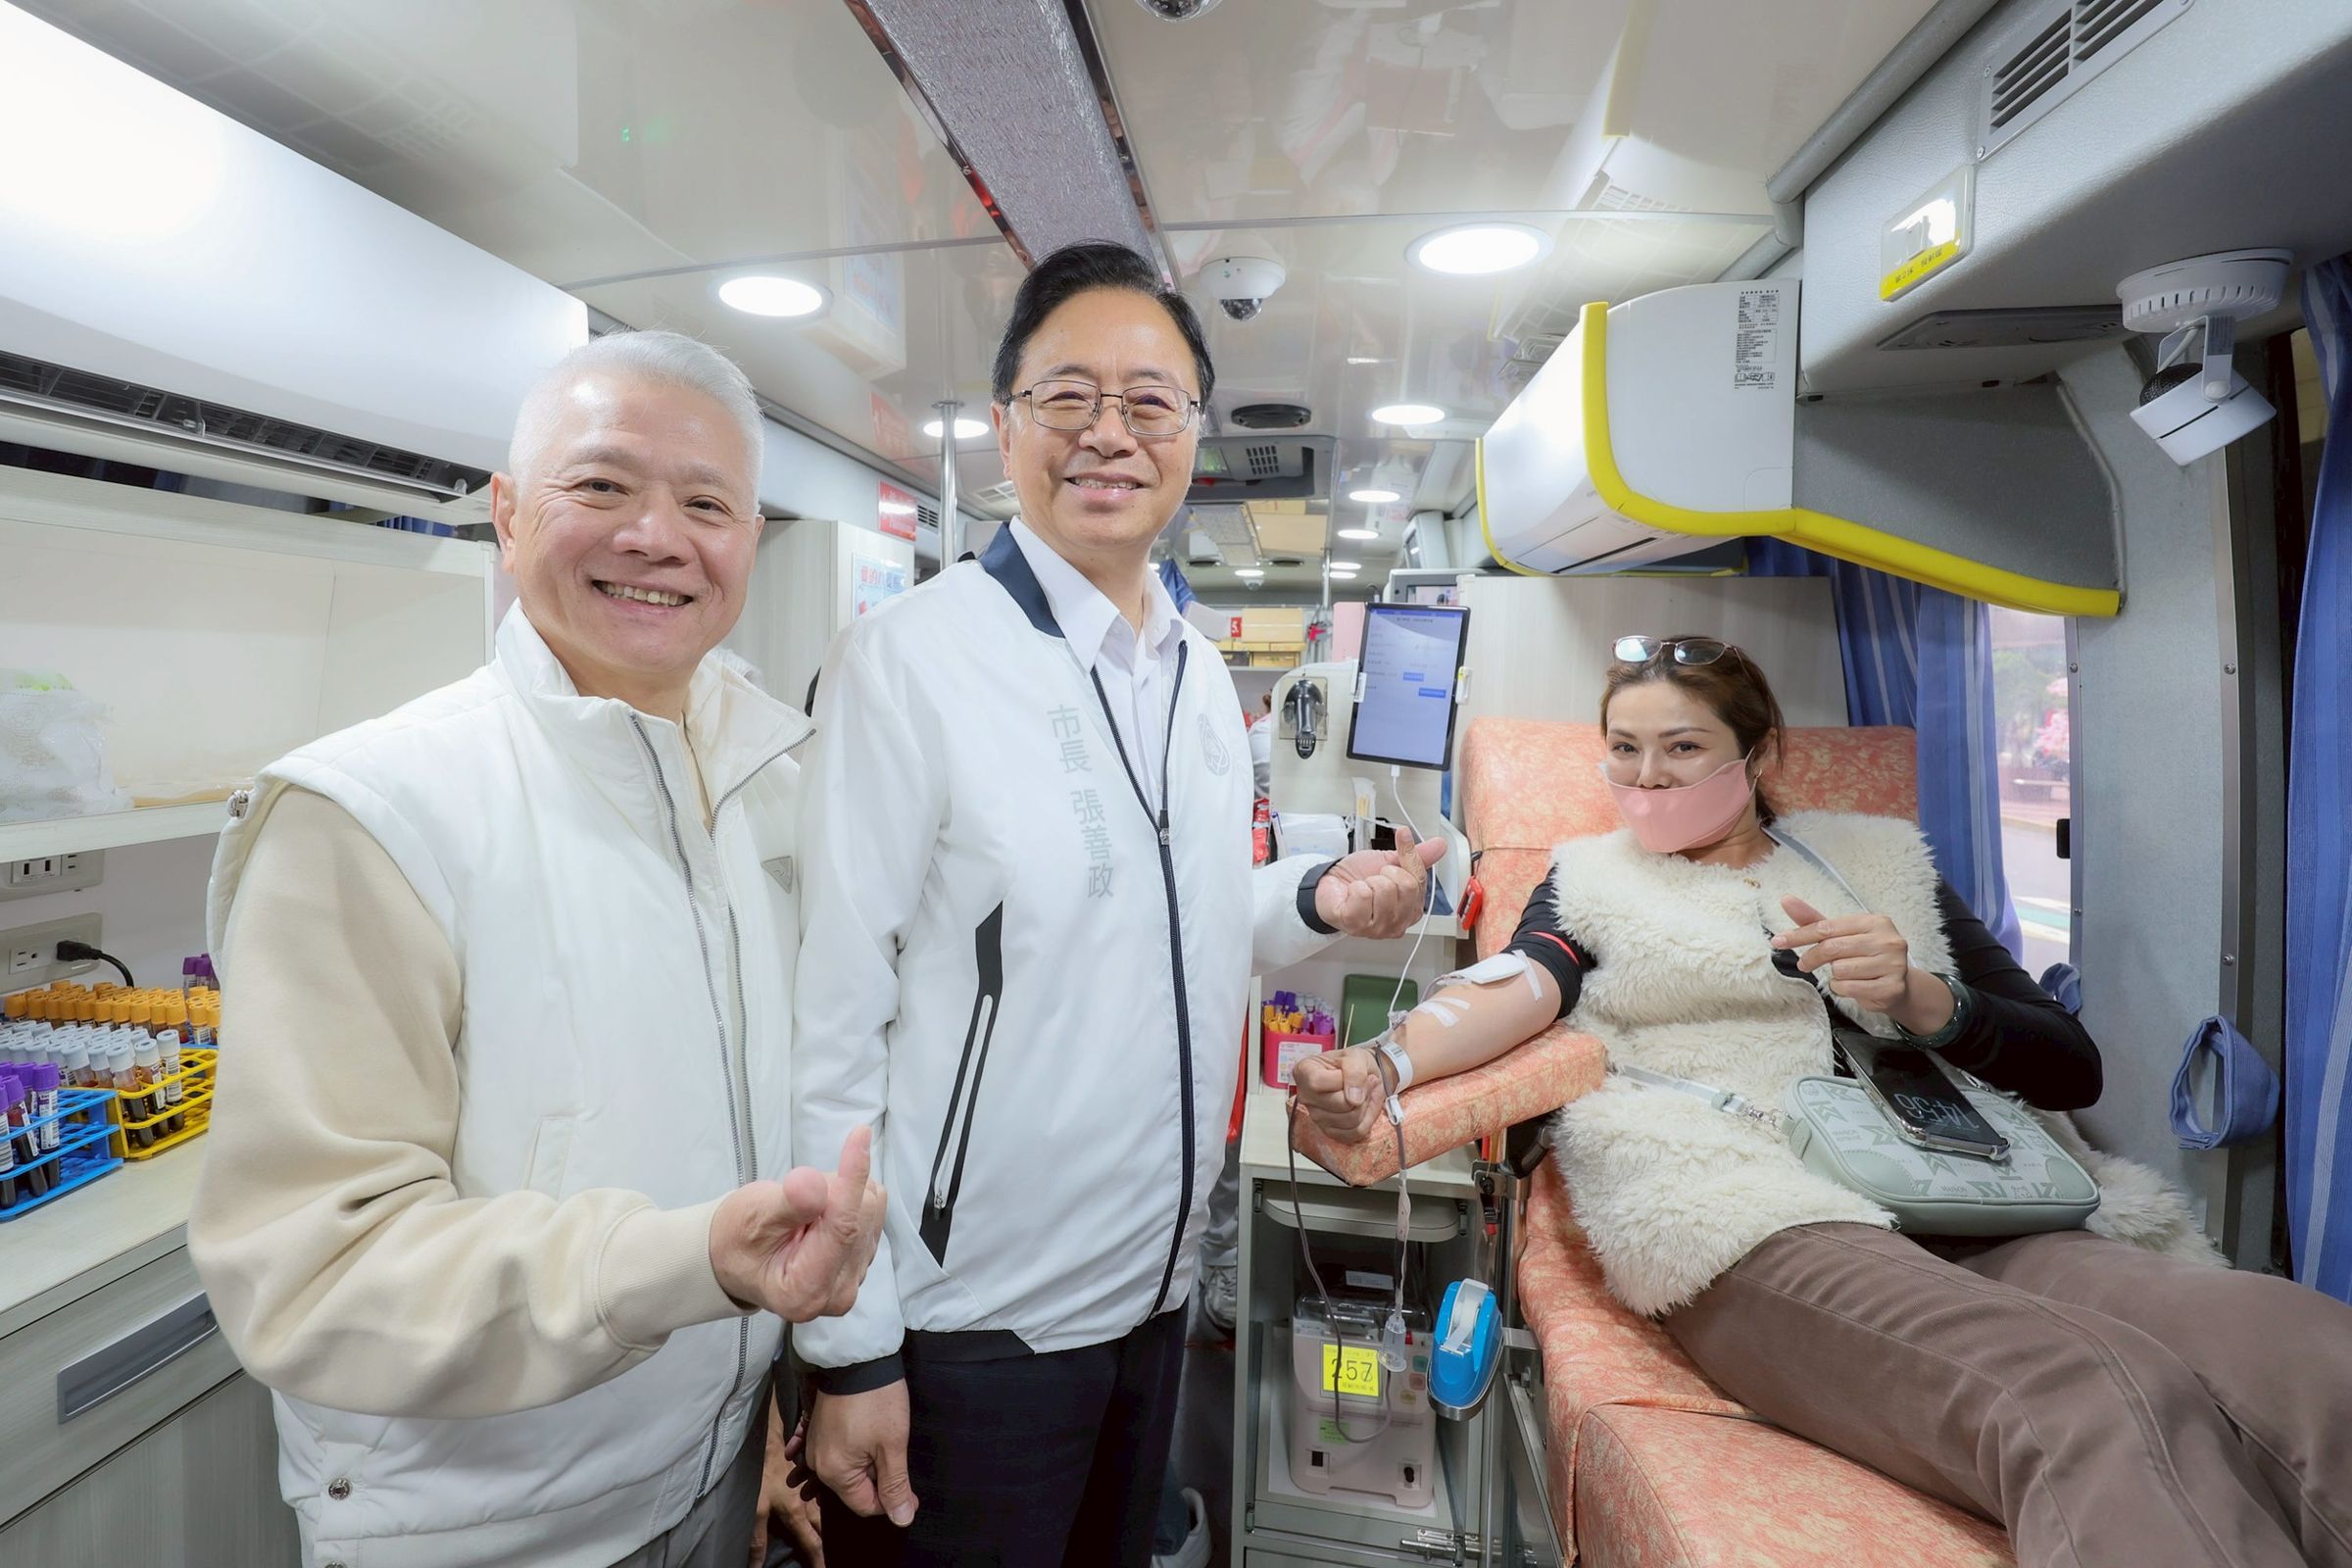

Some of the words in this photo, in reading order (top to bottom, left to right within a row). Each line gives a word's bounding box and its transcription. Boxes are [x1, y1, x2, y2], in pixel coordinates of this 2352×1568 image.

[1046, 704, 1093, 774] 市長
[1069, 788, 1114, 899] 張善政
[1331, 1357, 1373, 1383] 257
